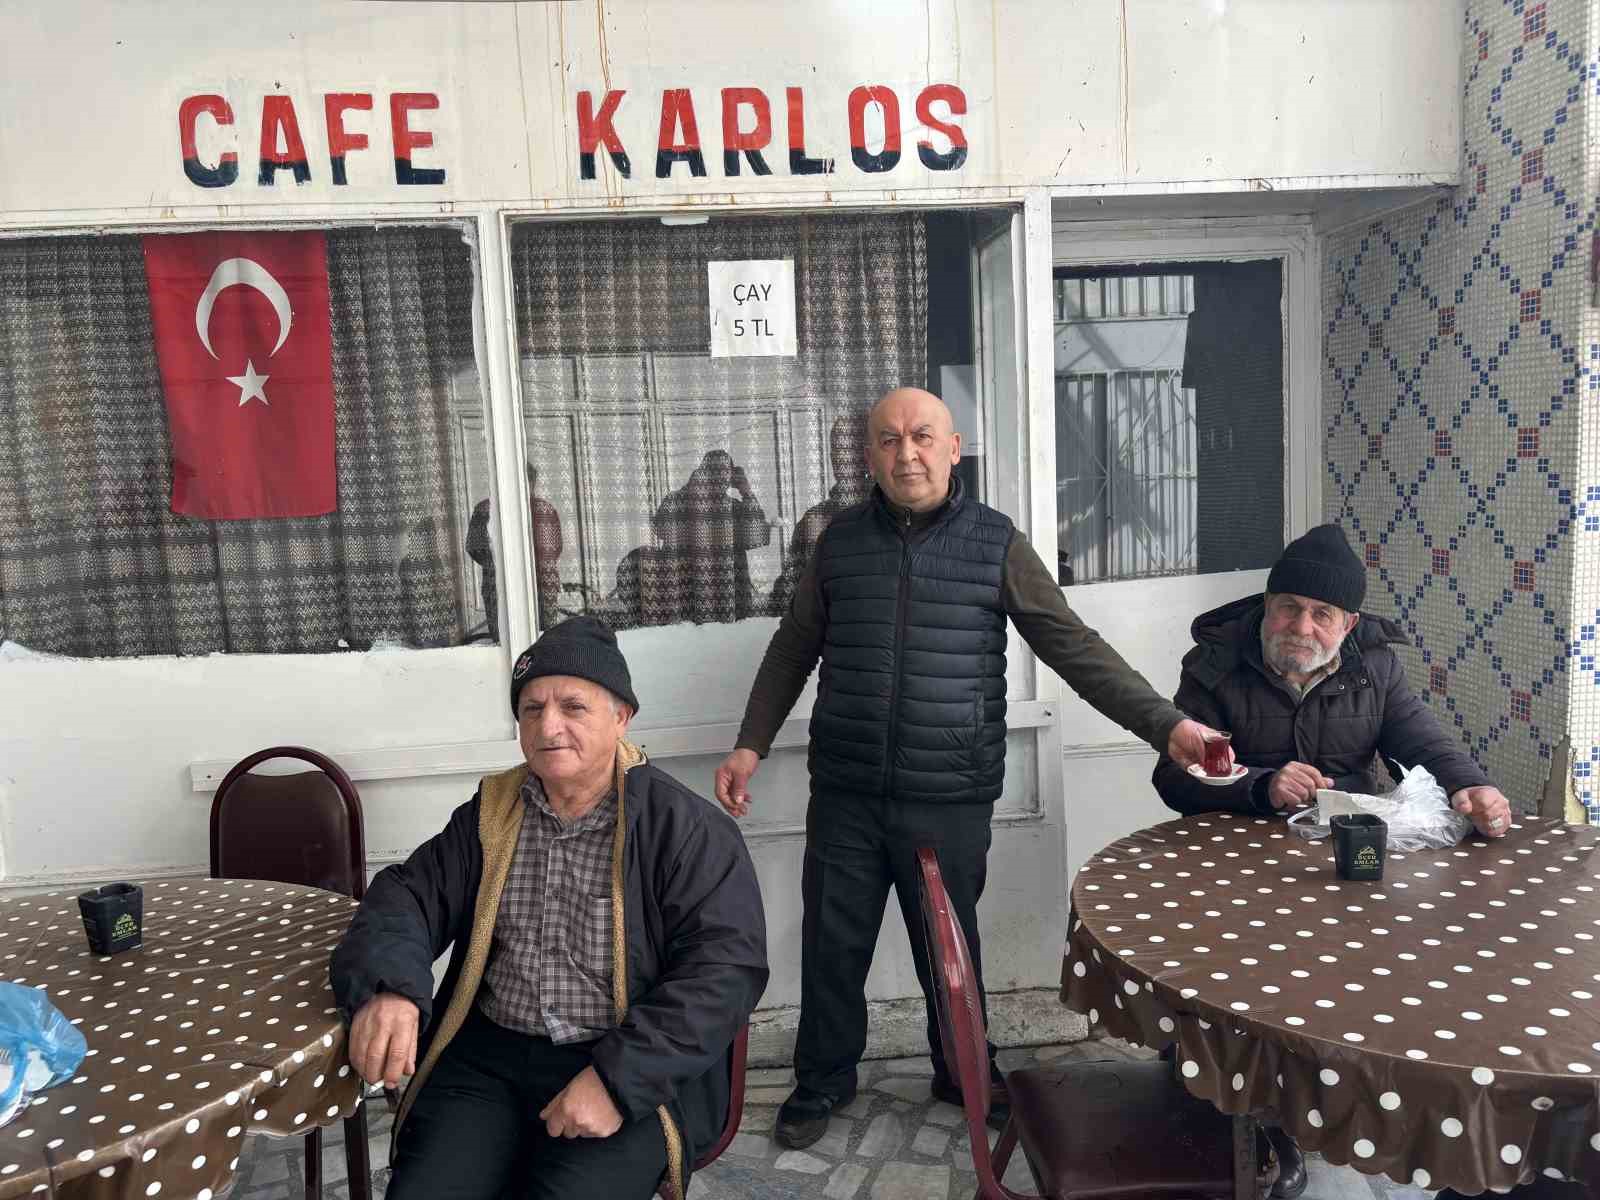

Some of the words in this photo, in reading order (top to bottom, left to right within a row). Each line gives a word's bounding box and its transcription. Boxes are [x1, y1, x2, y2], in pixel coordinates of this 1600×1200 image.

[179, 93, 446, 188] CAFE
[576, 83, 968, 180] KARLOS
[732, 283, 772, 306] ÇAY
[733, 319, 745, 337] 5
[751, 319, 775, 337] TL
